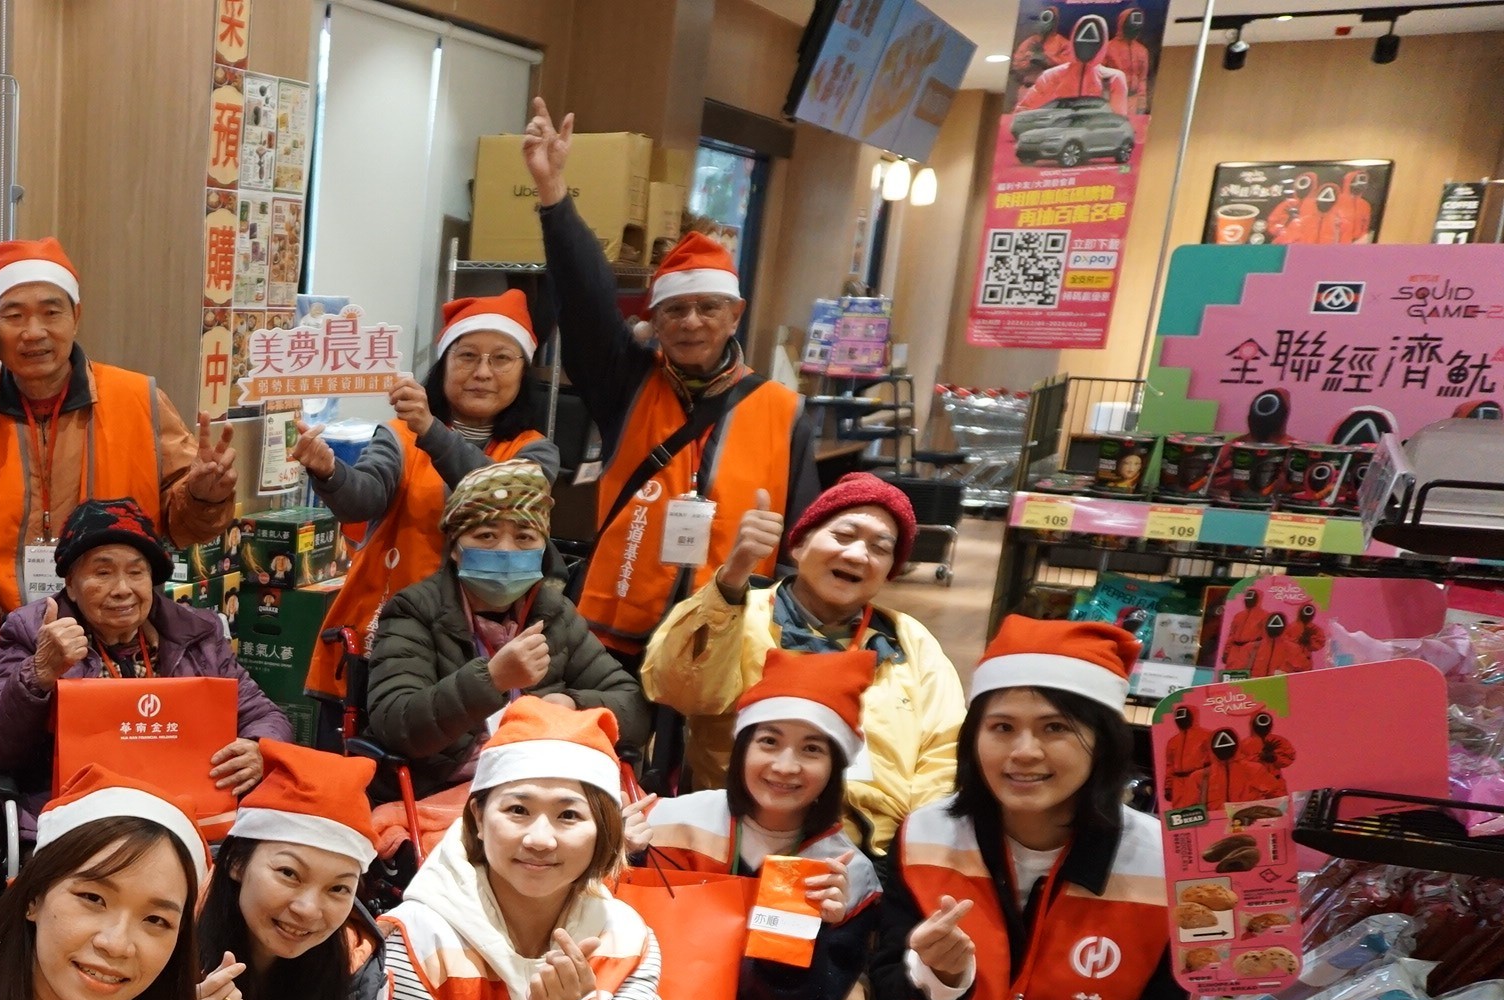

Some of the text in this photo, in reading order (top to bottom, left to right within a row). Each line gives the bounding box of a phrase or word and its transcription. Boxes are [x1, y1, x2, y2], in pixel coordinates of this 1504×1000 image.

[1391, 279, 1475, 304] SQUID
[1407, 304, 1486, 322] GAME
[253, 318, 399, 374] 美夢晨真
[1220, 330, 1504, 398] 全聯經濟魷
[1044, 514, 1068, 527] 109
[1169, 525, 1195, 538] 109
[1289, 534, 1316, 547] 109
[615, 504, 649, 598] 弘道基金會
[258, 605, 279, 614] QUAKER
[242, 641, 295, 660] 養氣人蔘
[1203, 692, 1247, 707] SQUID
[1213, 702, 1257, 714] GAME
[120, 721, 179, 734] 華南金控
